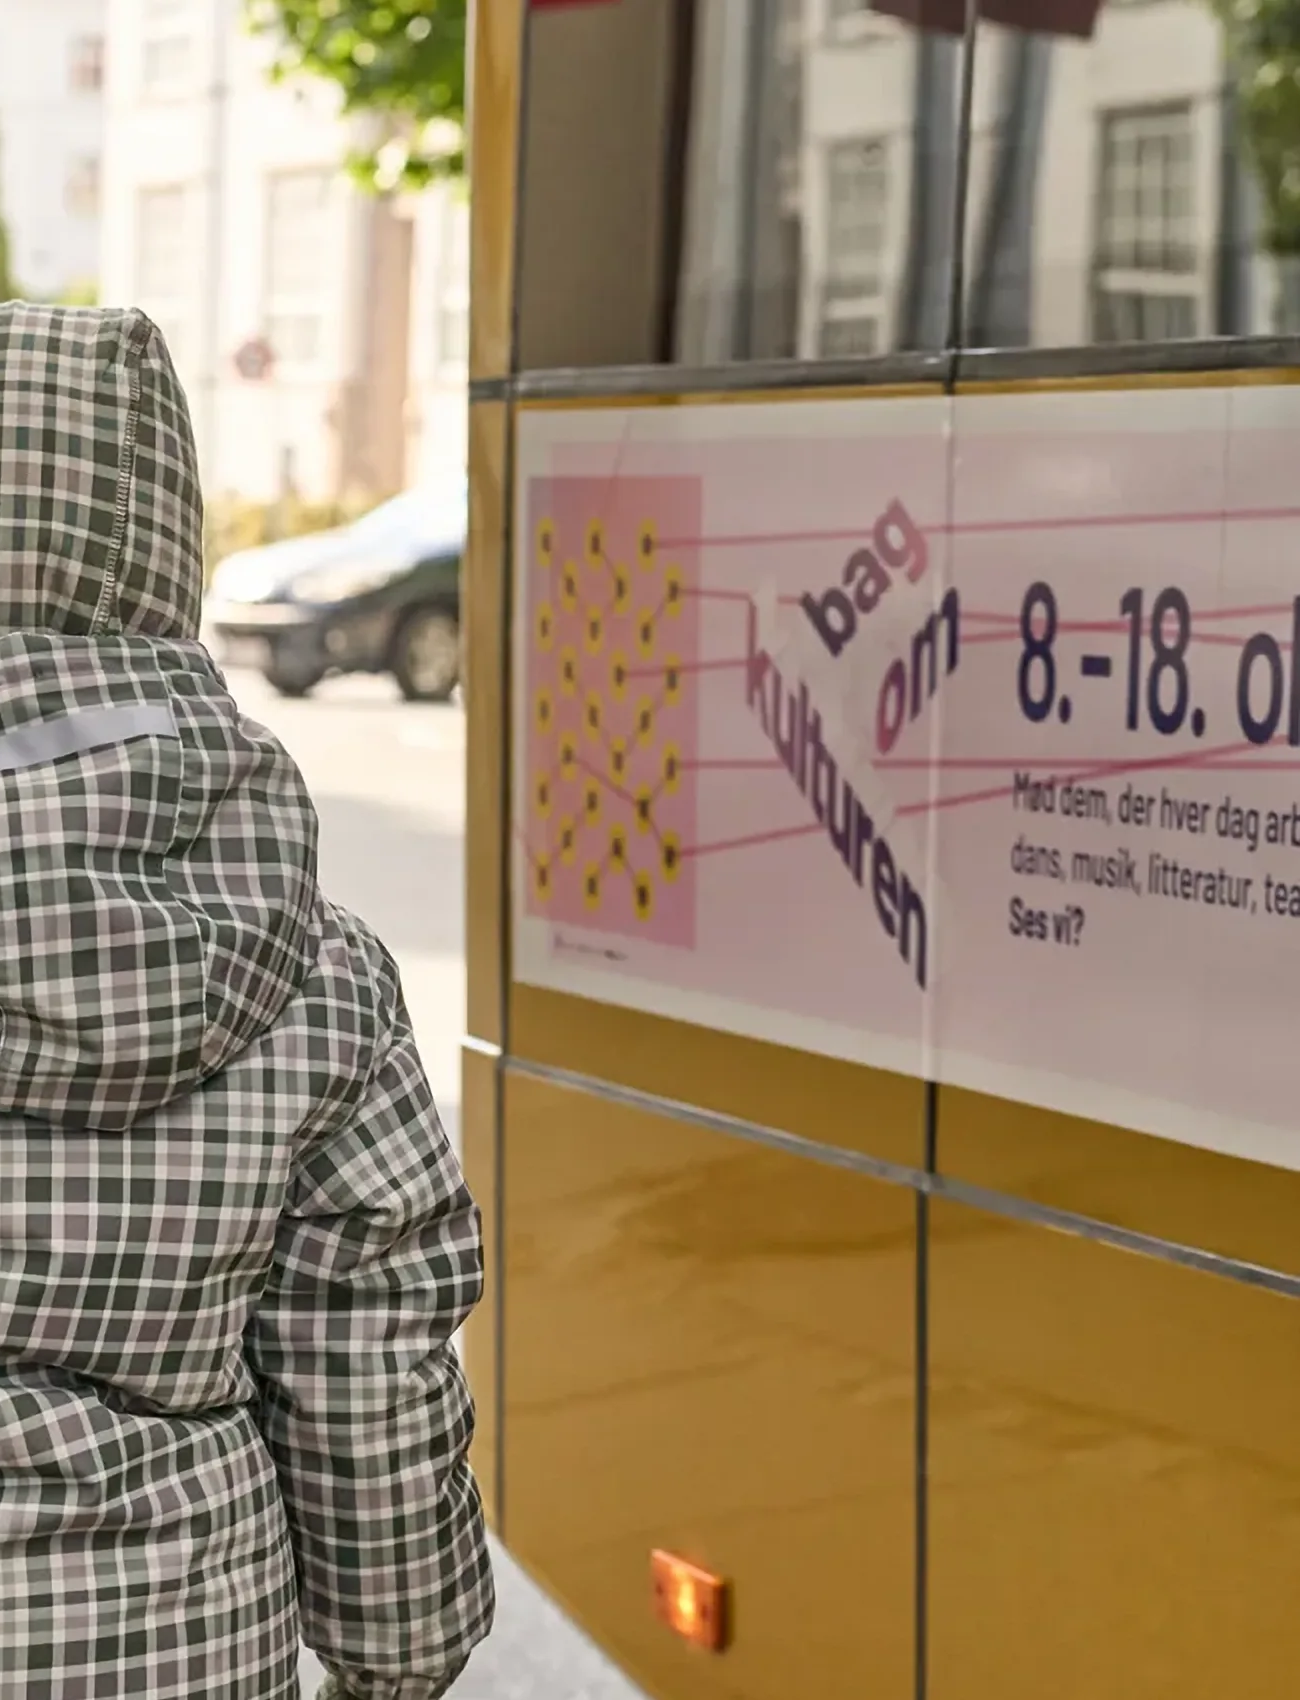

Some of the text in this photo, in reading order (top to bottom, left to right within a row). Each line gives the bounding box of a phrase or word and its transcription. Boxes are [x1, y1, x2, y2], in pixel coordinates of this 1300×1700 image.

[801, 497, 928, 658] bag
[876, 586, 958, 755] om
[1017, 580, 1206, 738] 8.-18.
[746, 648, 927, 990] kulturen
[1010, 835, 1300, 918] dans, musik, litteratur, tea
[1012, 770, 1055, 813] Mød
[1060, 777, 1112, 827] dem,
[1118, 782, 1155, 827] der
[1160, 787, 1211, 833] hver
[1216, 796, 1259, 852] dag
[1009, 897, 1085, 945] Ses vi?
